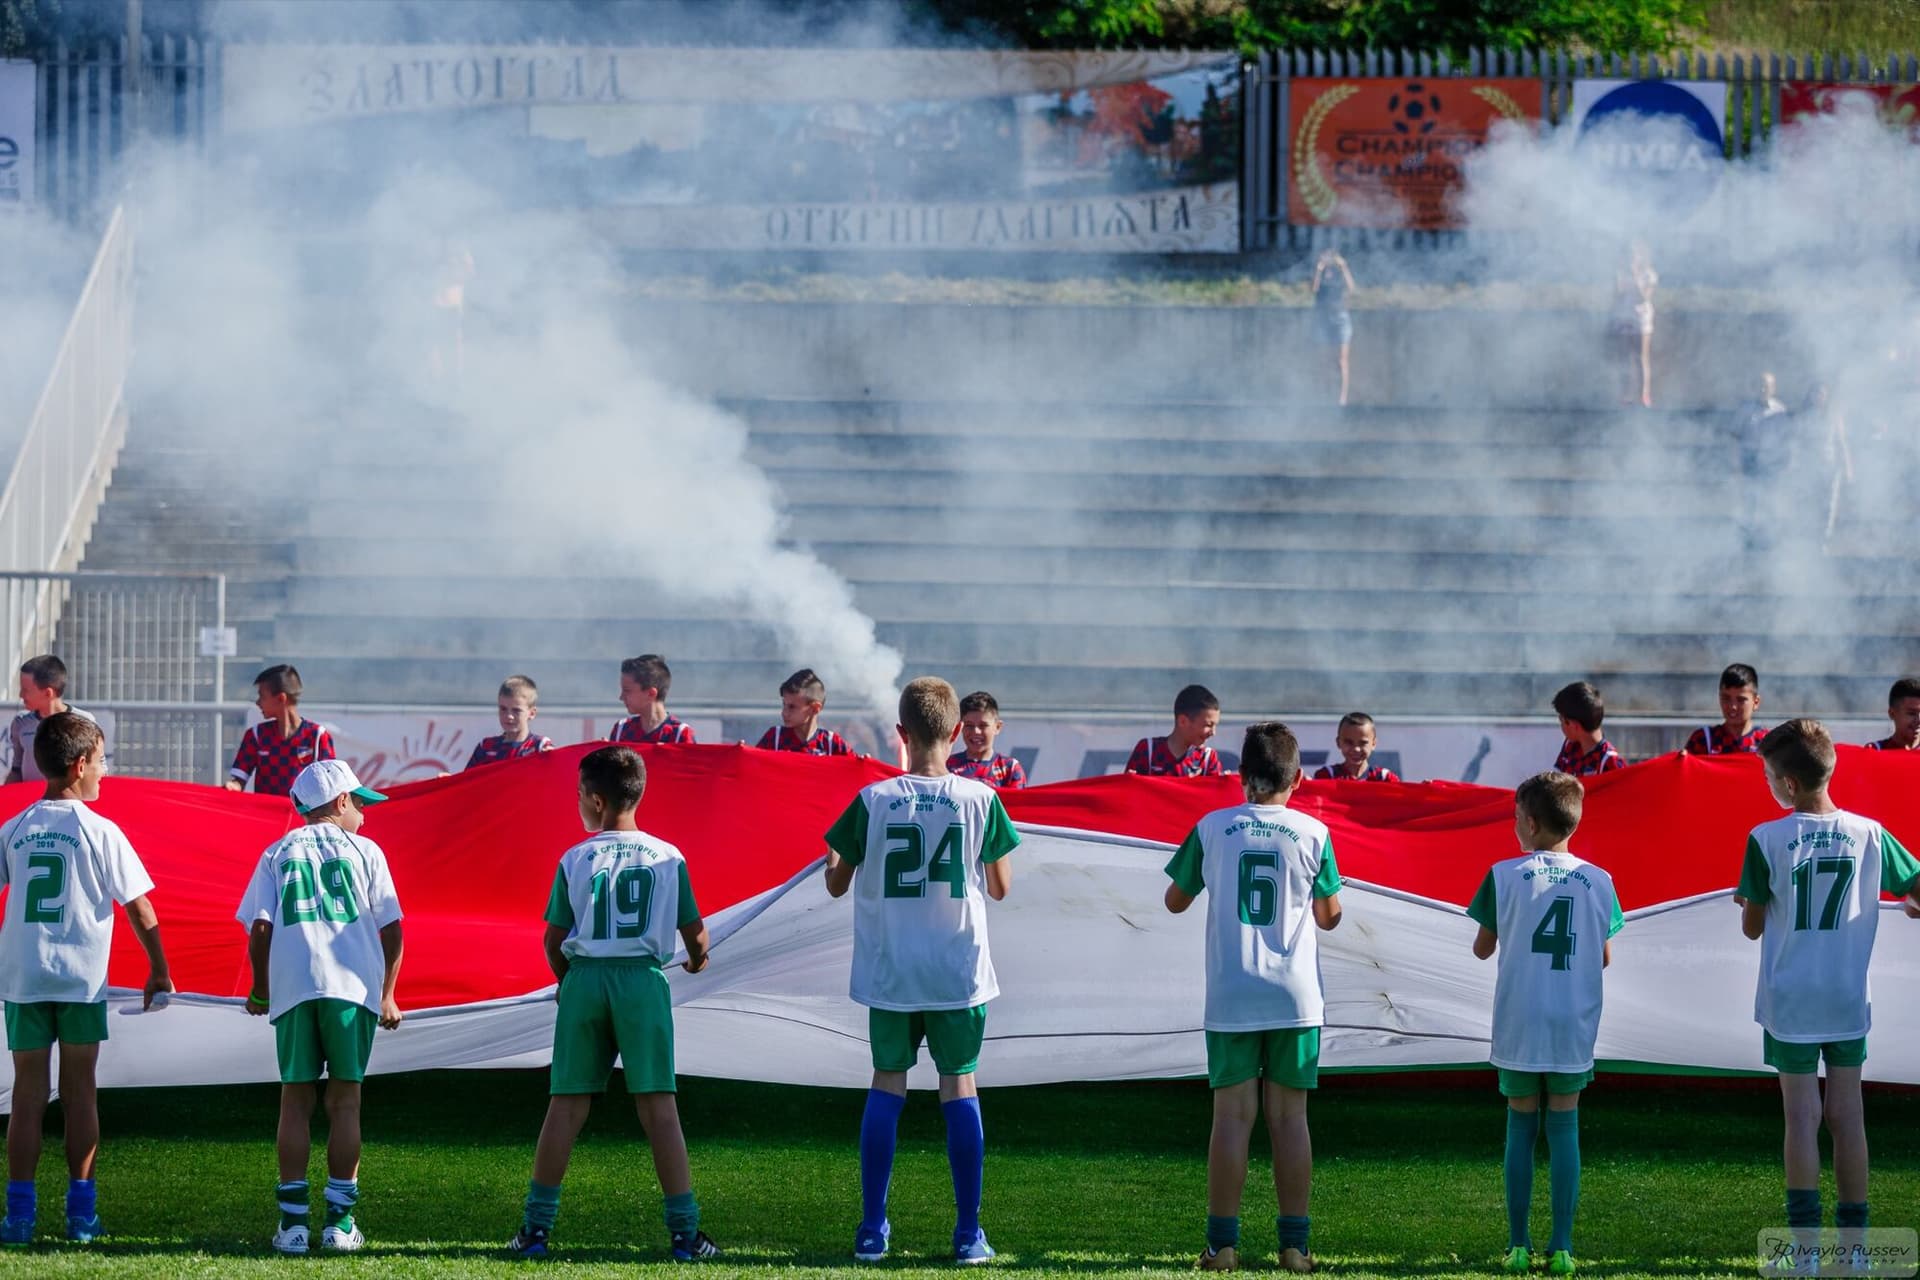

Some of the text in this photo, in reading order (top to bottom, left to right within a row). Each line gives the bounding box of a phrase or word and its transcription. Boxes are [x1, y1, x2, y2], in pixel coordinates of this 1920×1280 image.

[915, 804, 933, 812] 2016
[1251, 829, 1271, 838] 2016
[884, 823, 968, 898] 24
[1812, 840, 1831, 848] 2016
[24, 852, 67, 923] 2
[280, 857, 359, 927] 28
[591, 865, 656, 940] 19
[1237, 850, 1278, 926] 6
[1548, 876, 1568, 885] 2016
[1792, 856, 1856, 931] 17
[1531, 895, 1576, 971] 4
